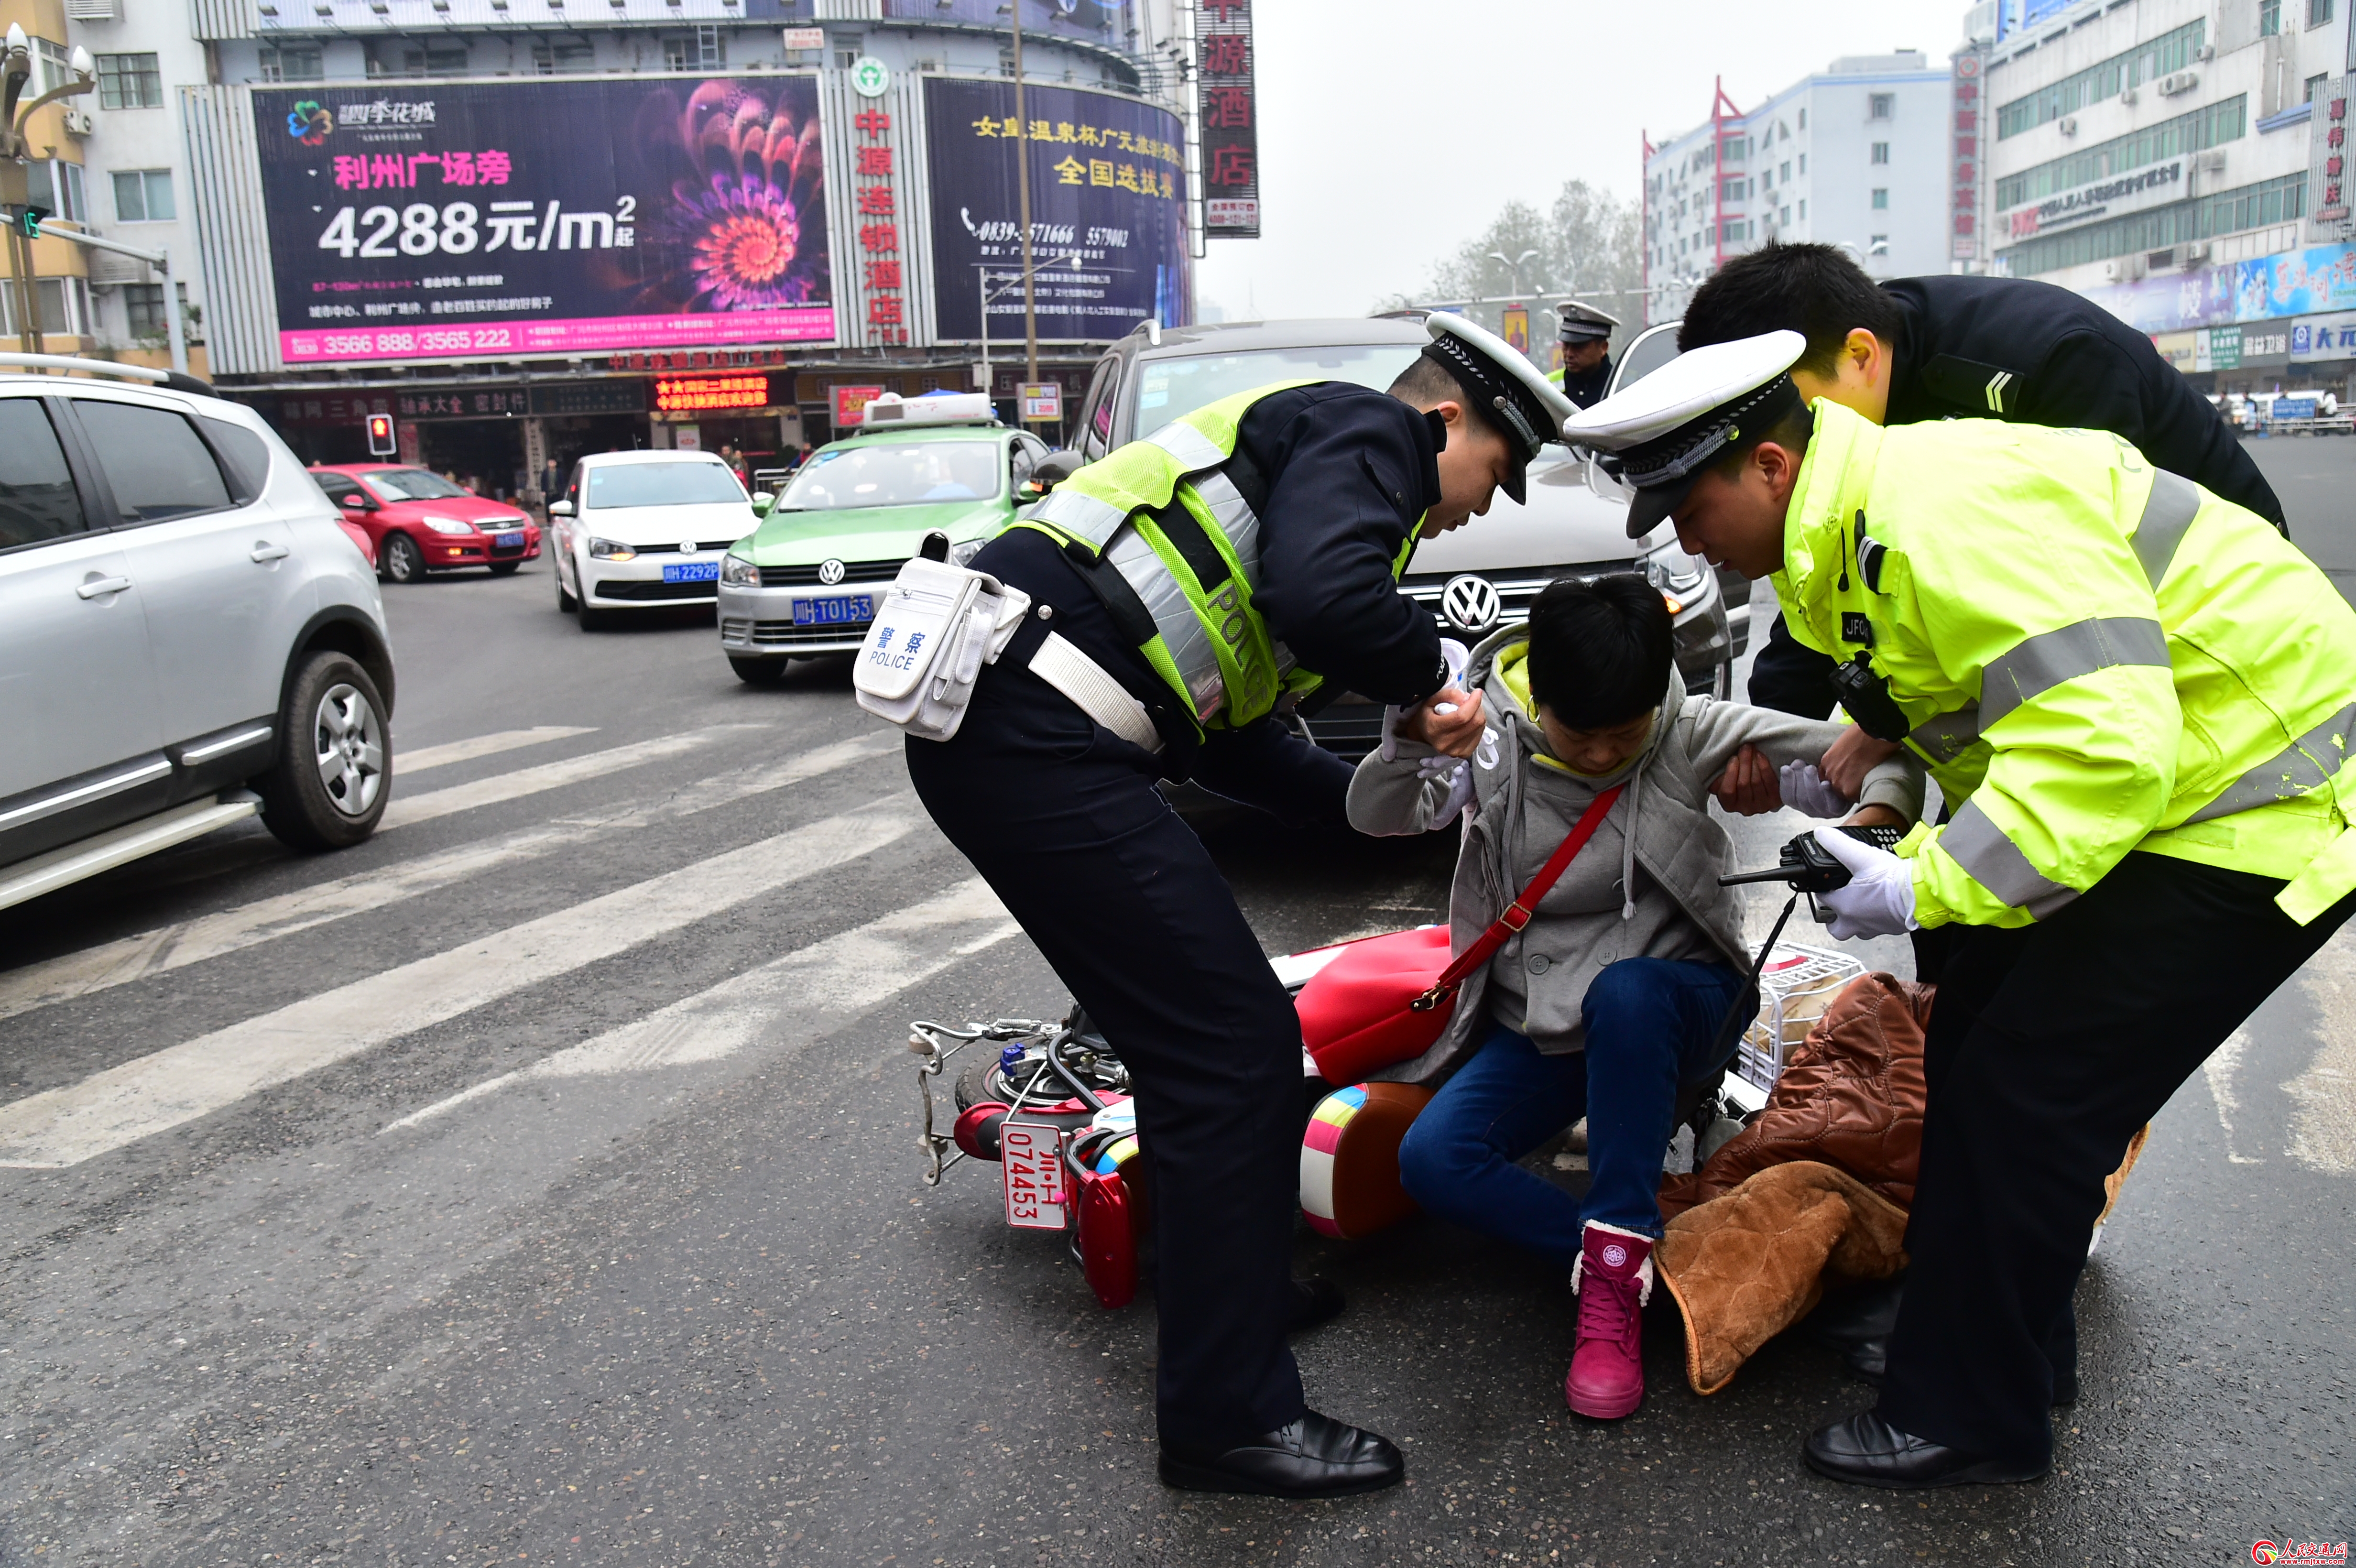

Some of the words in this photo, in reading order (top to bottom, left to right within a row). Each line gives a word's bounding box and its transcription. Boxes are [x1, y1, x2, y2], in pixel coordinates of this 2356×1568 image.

[335, 149, 512, 190] 利州广场旁
[1053, 154, 1173, 199] 全国选拔赛
[855, 109, 903, 324] 中源连锁酒店
[324, 336, 373, 355] 3566
[475, 329, 511, 348] 222
[869, 651, 915, 670] POLICE
[877, 627, 926, 654] 警察
[1207, 584, 1269, 715] POLICE
[1007, 1133, 1037, 1219] 074453
